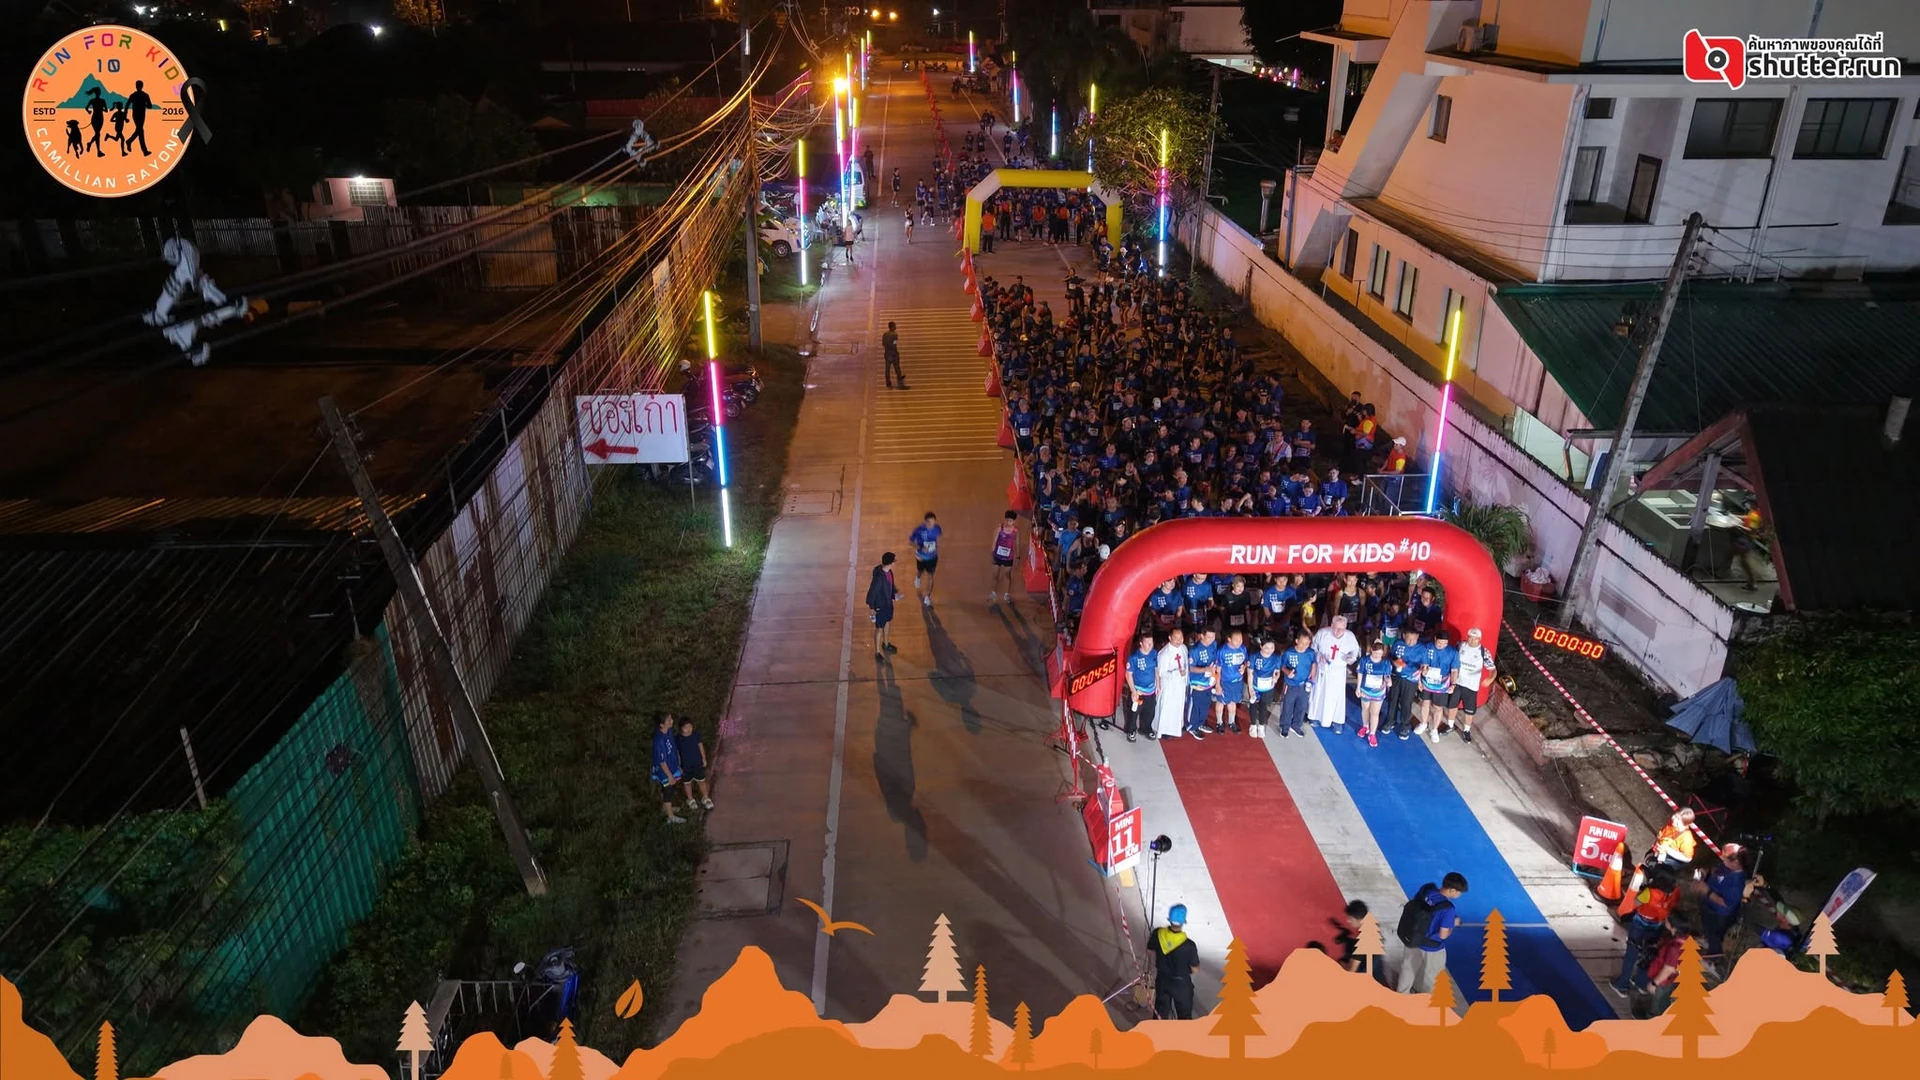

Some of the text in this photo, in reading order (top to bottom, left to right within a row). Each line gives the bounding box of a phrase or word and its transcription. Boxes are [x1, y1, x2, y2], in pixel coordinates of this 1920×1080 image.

[581, 394, 678, 434] ของเก่า
[1230, 537, 1431, 564] RUN FOR KIDS #10
[1533, 626, 1604, 658] 00:00:00
[1115, 814, 1134, 832] MINI
[1588, 825, 1618, 841] FUN RUN
[1112, 826, 1136, 857] 11
[1580, 834, 1601, 860] 5
